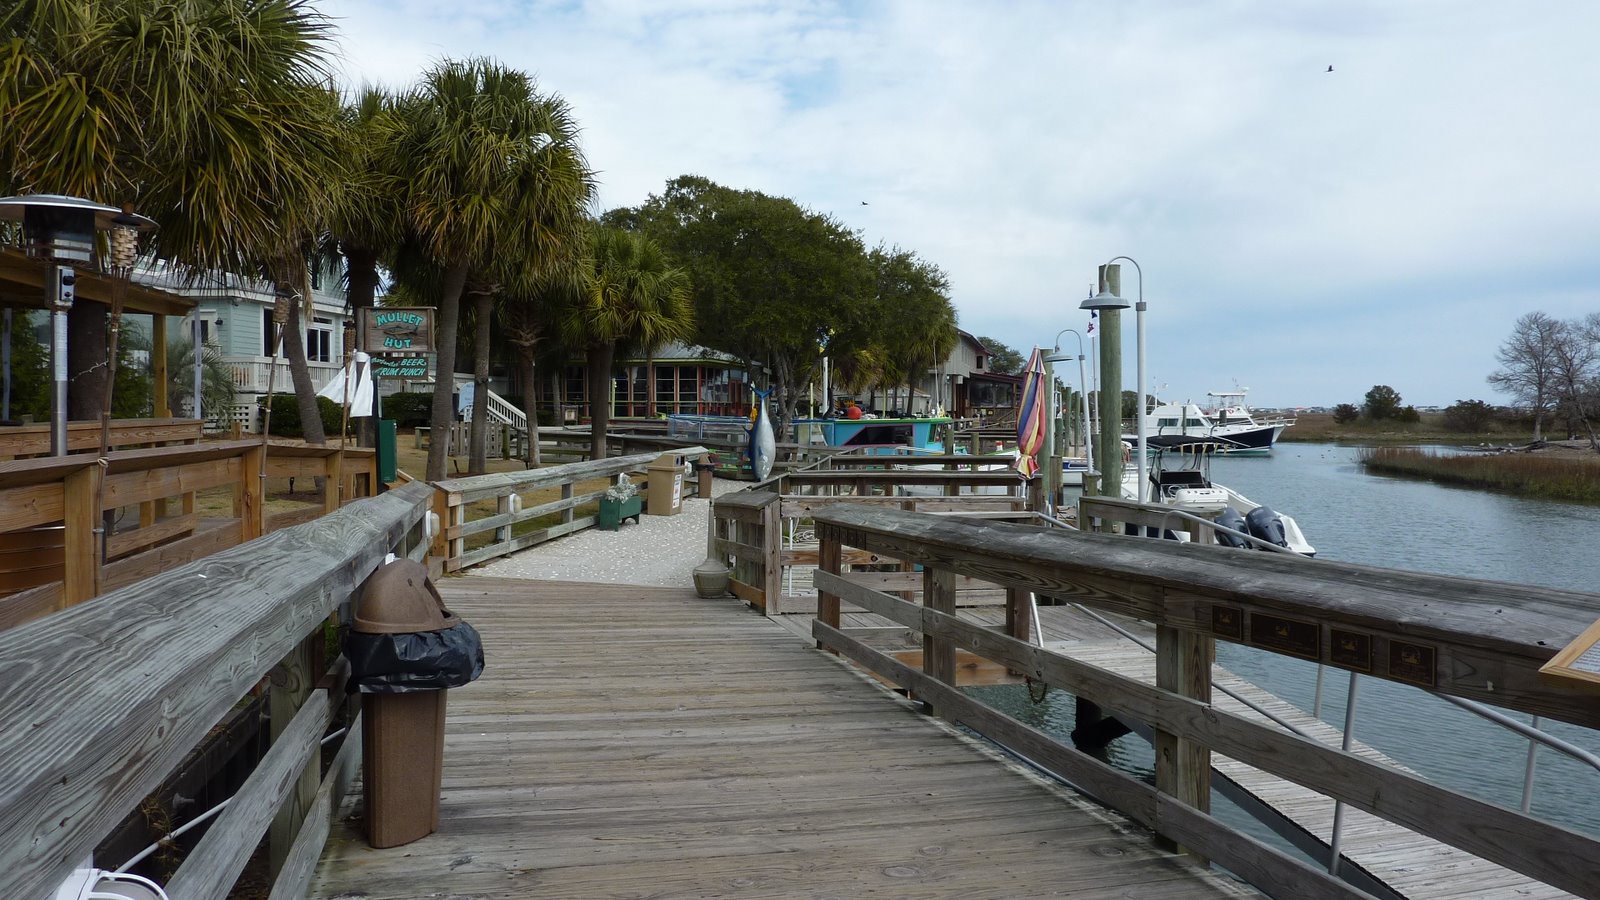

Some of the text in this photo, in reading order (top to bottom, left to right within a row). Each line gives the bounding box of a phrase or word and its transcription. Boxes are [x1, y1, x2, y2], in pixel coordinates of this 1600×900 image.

[376, 312, 423, 326] MULLET
[384, 337, 412, 349] HUT
[380, 367, 400, 376] RUM
[400, 367, 426, 376] PUNCH
